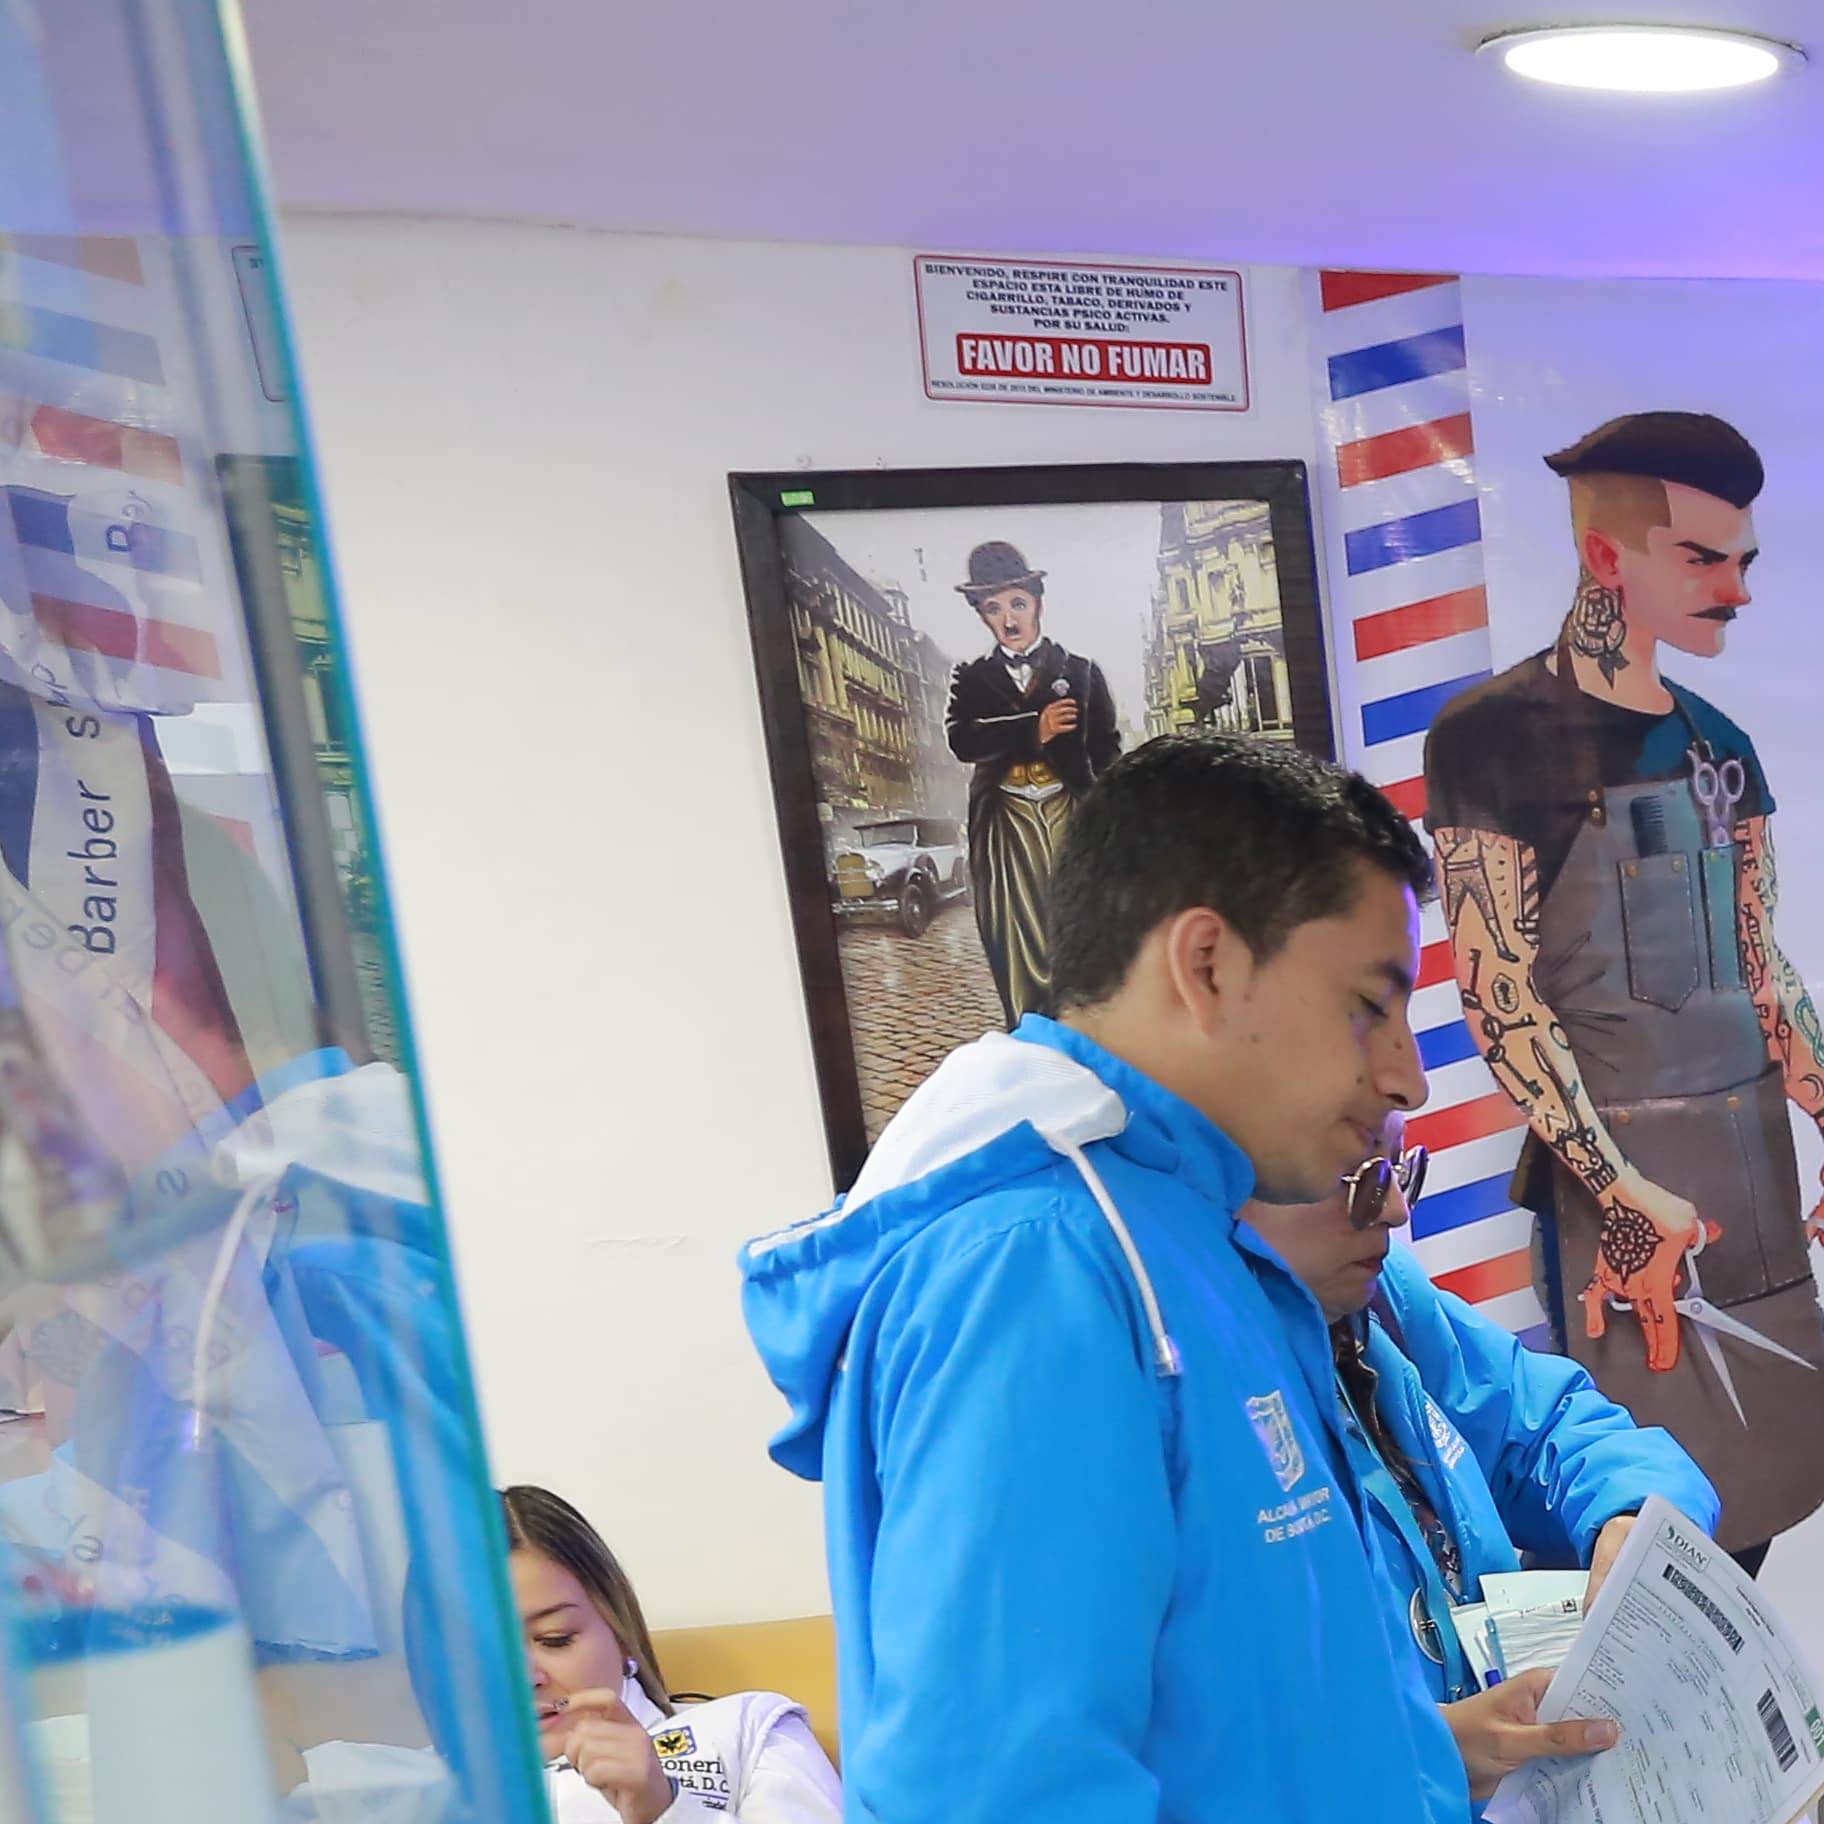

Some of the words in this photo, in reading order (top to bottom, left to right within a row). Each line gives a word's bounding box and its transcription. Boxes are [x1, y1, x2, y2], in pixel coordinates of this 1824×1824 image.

[925, 264, 1009, 280] BIENVENIDO,
[1013, 269, 1069, 282] RESPIRE
[1072, 273, 1098, 284] CON
[1102, 275, 1195, 289] TRANQUILIDAD
[1198, 280, 1228, 291] ESTE
[966, 291, 1048, 305] CIGARRILLO,
[1052, 296, 1104, 309] TABACO,
[1108, 299, 1181, 312] DERIVADOS
[1184, 303, 1192, 313] Y
[972, 279, 1028, 292] ESPACIO
[1031, 282, 1062, 294] ESTA
[1065, 284, 1102, 297] LIBRE
[1106, 287, 1123, 297] DE
[1126, 288, 1164, 299] HUMO
[1167, 290, 1185, 301] DE
[990, 305, 1069, 318] SUSTANCIAS
[1072, 309, 1112, 320] PSICO
[1033, 318, 1060, 329] POR
[1064, 320, 1082, 331] SU
[961, 338, 1054, 374] FAVOR
[1061, 342, 1101, 376] NO
[1107, 345, 1207, 380] FUMAR
[66, 779, 119, 956] Barber
[1673, 1534, 1705, 1565] DIAN
